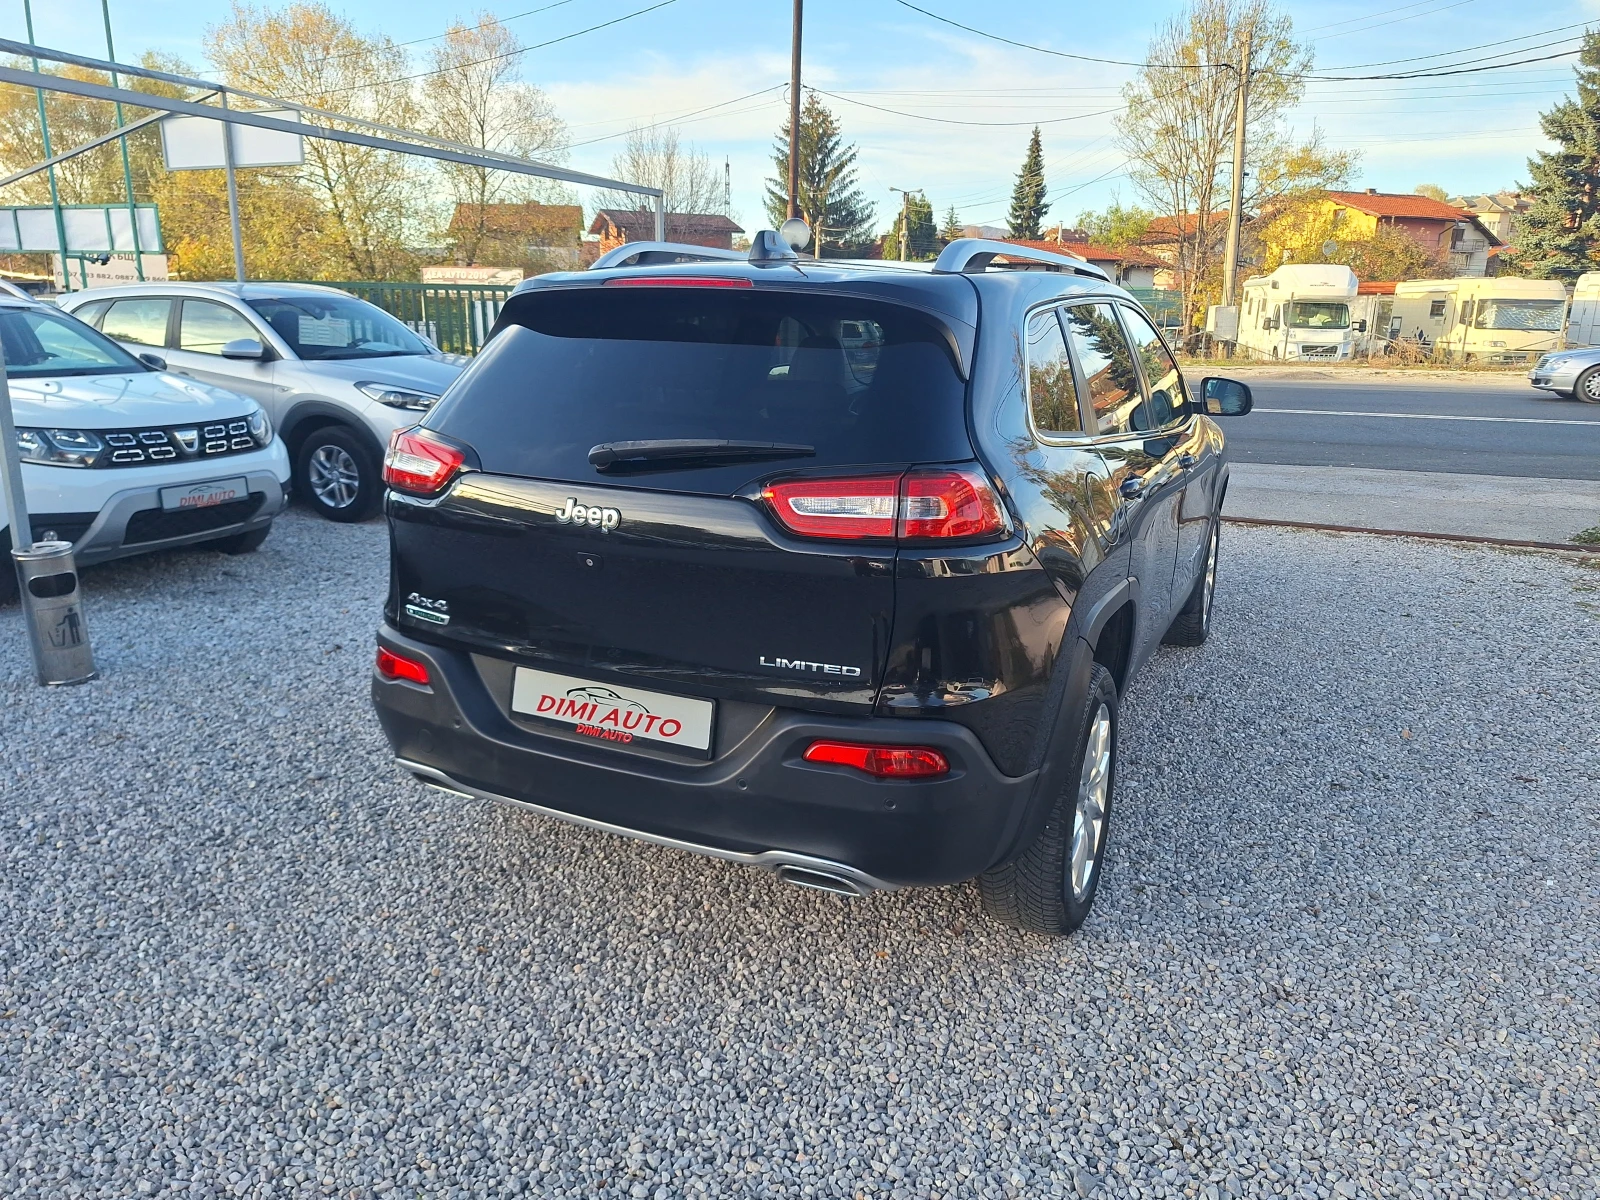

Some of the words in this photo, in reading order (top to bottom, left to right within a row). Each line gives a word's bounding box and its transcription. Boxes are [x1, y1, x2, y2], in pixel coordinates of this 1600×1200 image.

[468, 270, 488, 280] 2014
[180, 495, 205, 507] DIMI
[207, 490, 235, 503] AUTO
[555, 497, 622, 534] Jeep
[408, 592, 448, 611] 4x4
[759, 656, 861, 677] LIMITED
[536, 694, 600, 722] DIMI
[598, 708, 682, 737] AUTO
[575, 723, 600, 737] DIMI
[599, 727, 634, 744] AUTO
